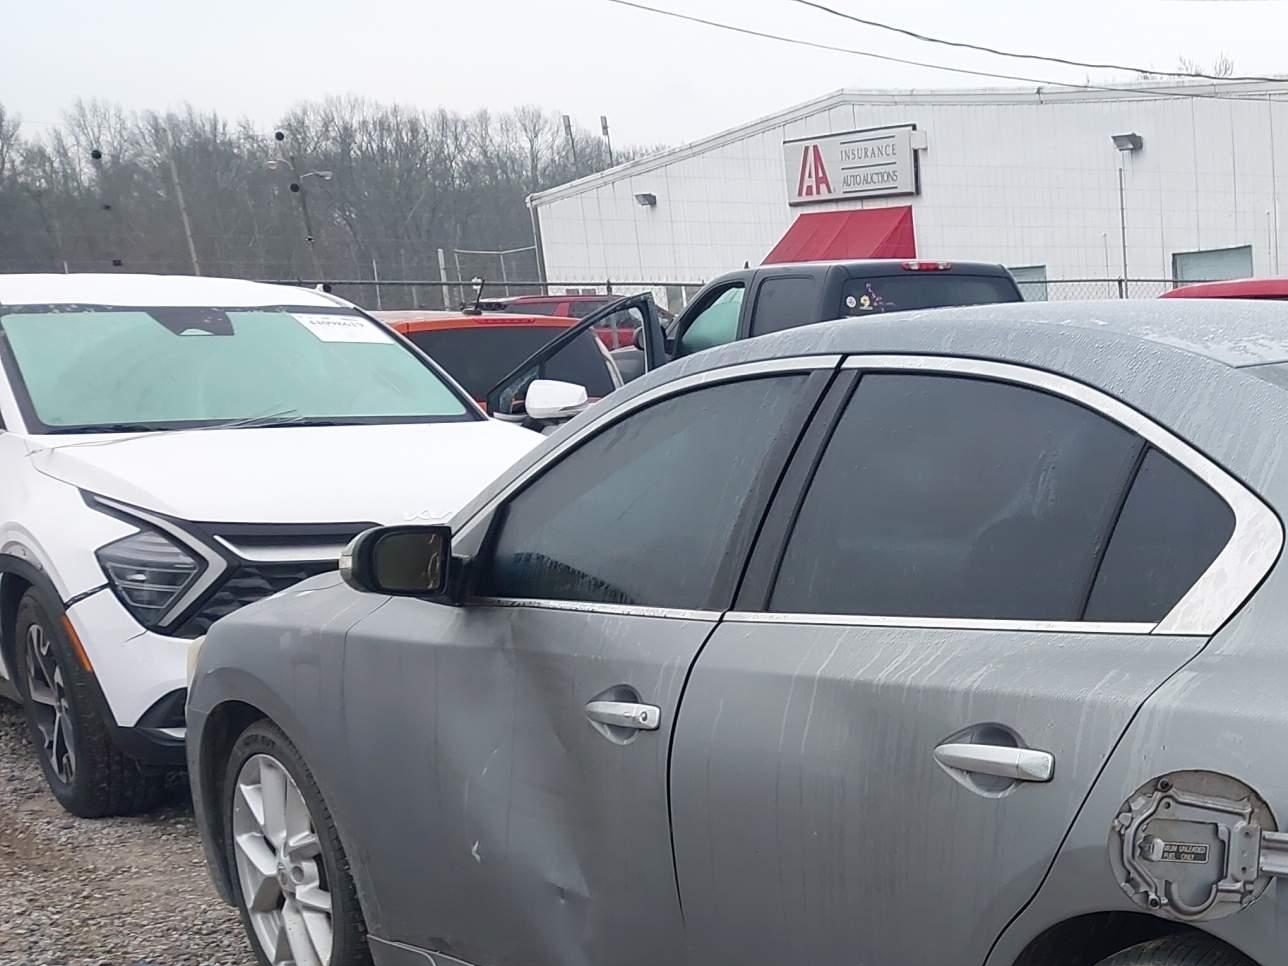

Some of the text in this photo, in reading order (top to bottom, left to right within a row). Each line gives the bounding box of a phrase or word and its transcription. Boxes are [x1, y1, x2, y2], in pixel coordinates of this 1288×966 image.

[840, 143, 897, 161] INSURANCE
[842, 170, 898, 187] AUTO AUCTIONS
